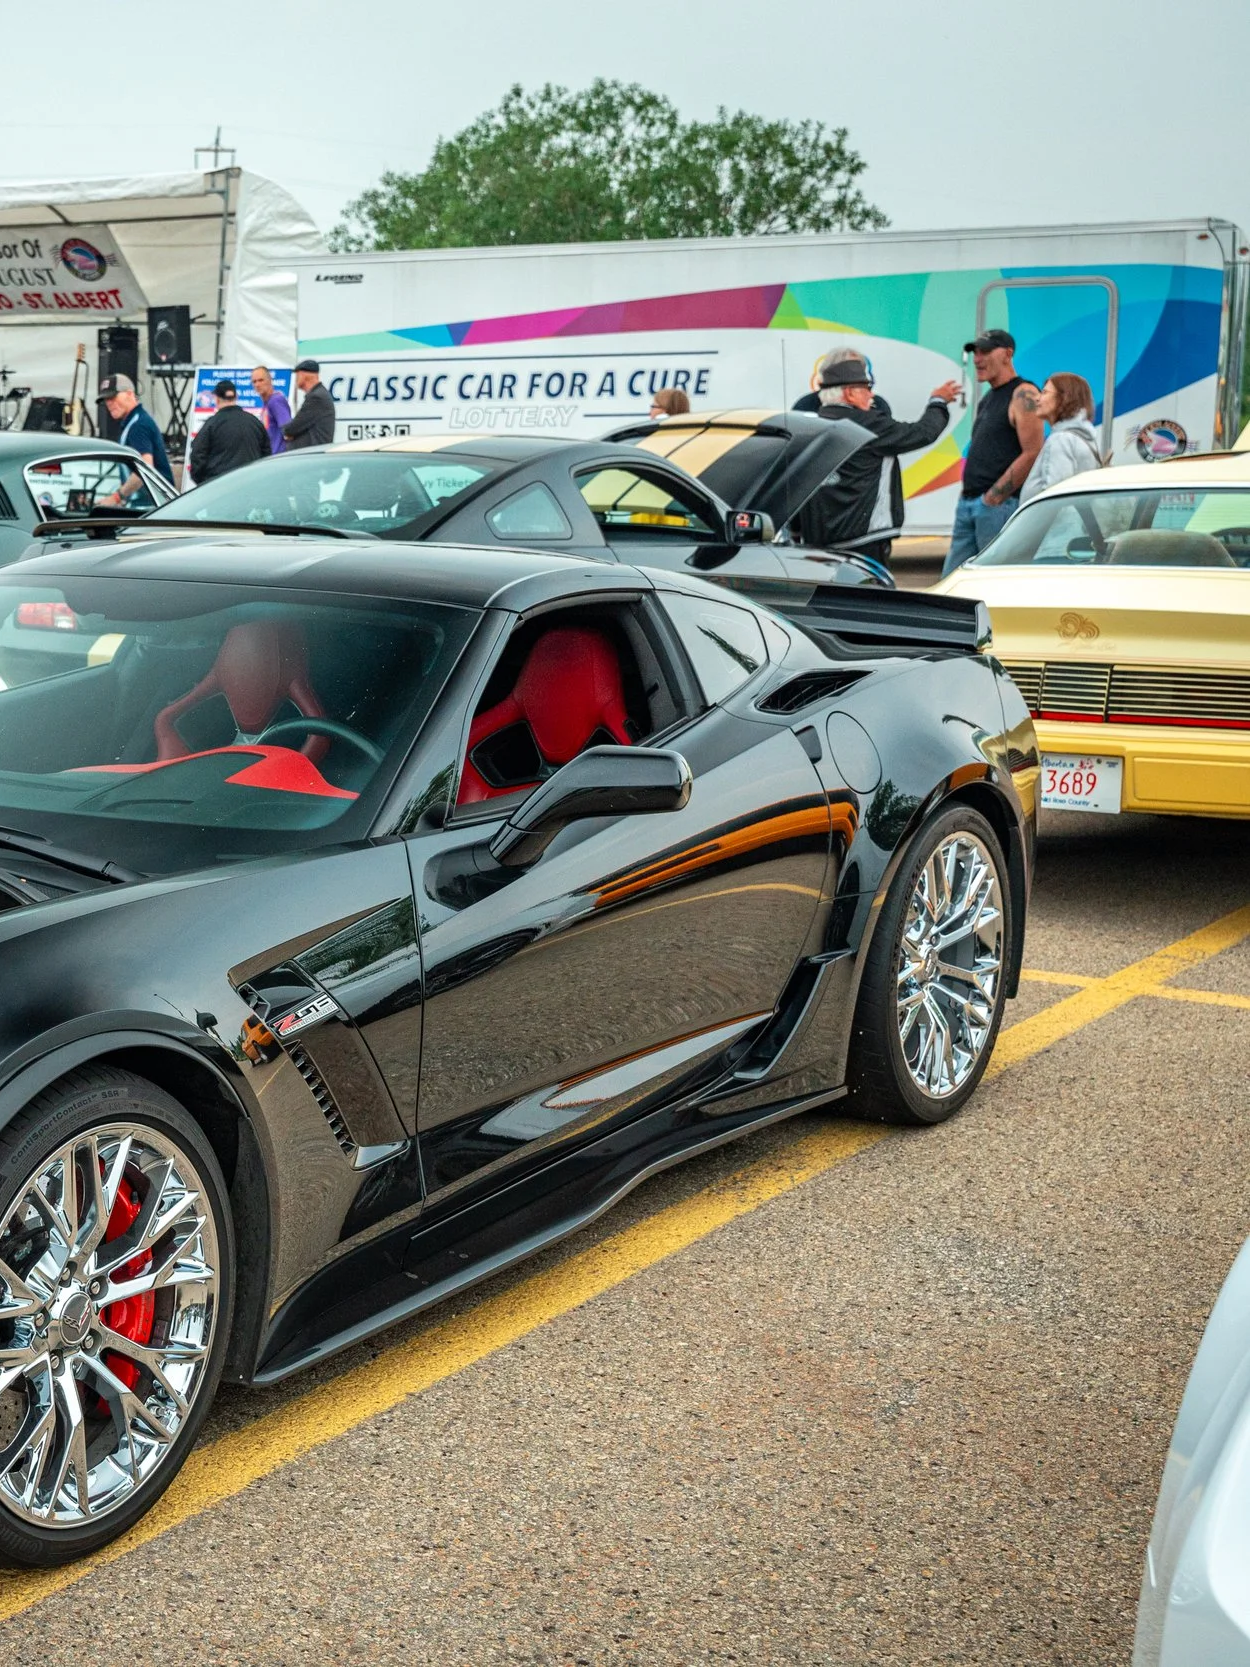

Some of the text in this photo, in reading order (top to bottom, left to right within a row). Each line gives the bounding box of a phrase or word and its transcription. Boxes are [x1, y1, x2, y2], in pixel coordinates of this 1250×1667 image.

[22, 239, 43, 258] Of
[22, 291, 52, 310] ST.
[57, 289, 124, 310] ALBERT
[330, 368, 710, 402] CLASSIC CAR FOR A CURE
[449, 405, 579, 430] LOTTERY
[1046, 769, 1097, 796] 3689
[101, 1089, 120, 1099] SSR
